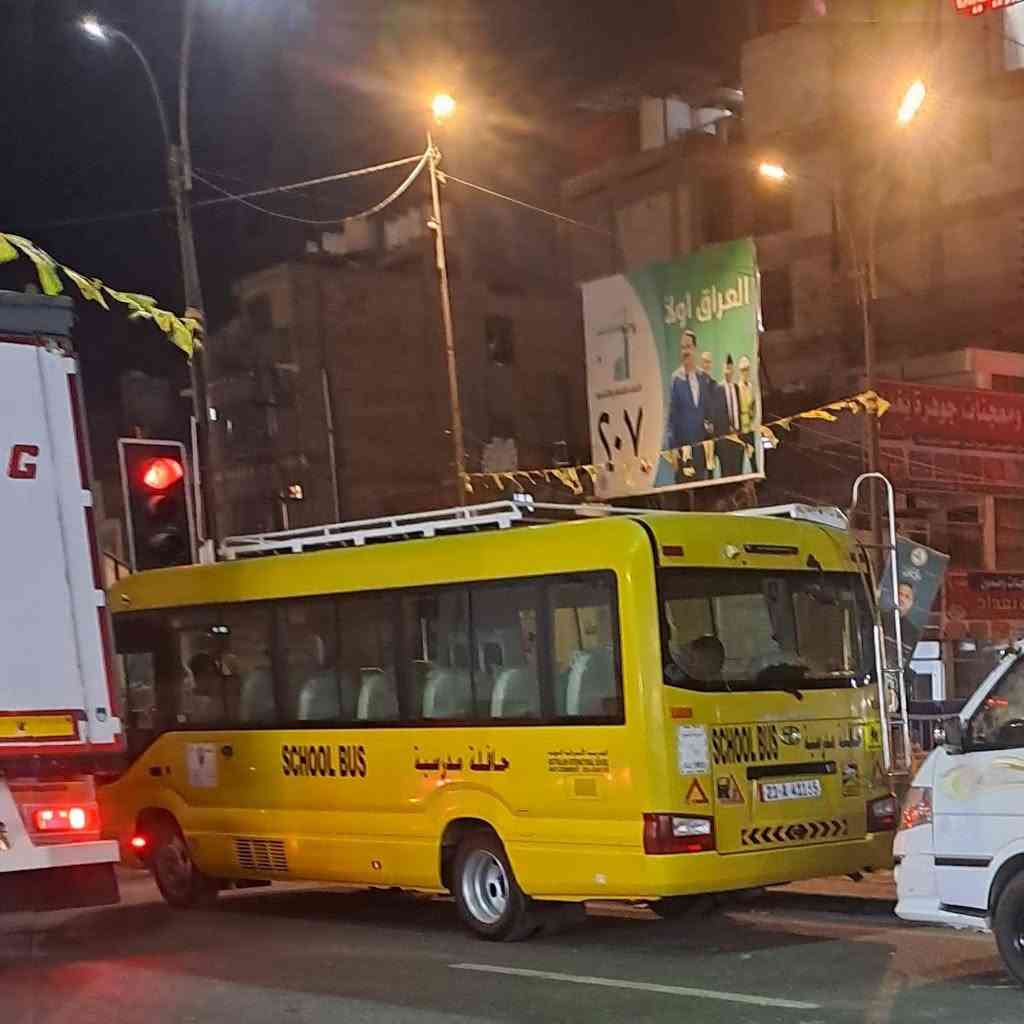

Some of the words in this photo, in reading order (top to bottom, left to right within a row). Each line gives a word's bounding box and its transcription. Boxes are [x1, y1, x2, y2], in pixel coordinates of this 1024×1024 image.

[696, 275, 750, 323] العراق
[8, 444, 39, 480] G
[282, 744, 337, 777] SCHOOL
[338, 744, 367, 778] BUS
[413, 745, 463, 779] مدرسية
[468, 744, 510, 772] حافلة
[712, 727, 755, 765] SCHOOL
[756, 724, 778, 762] BUS
